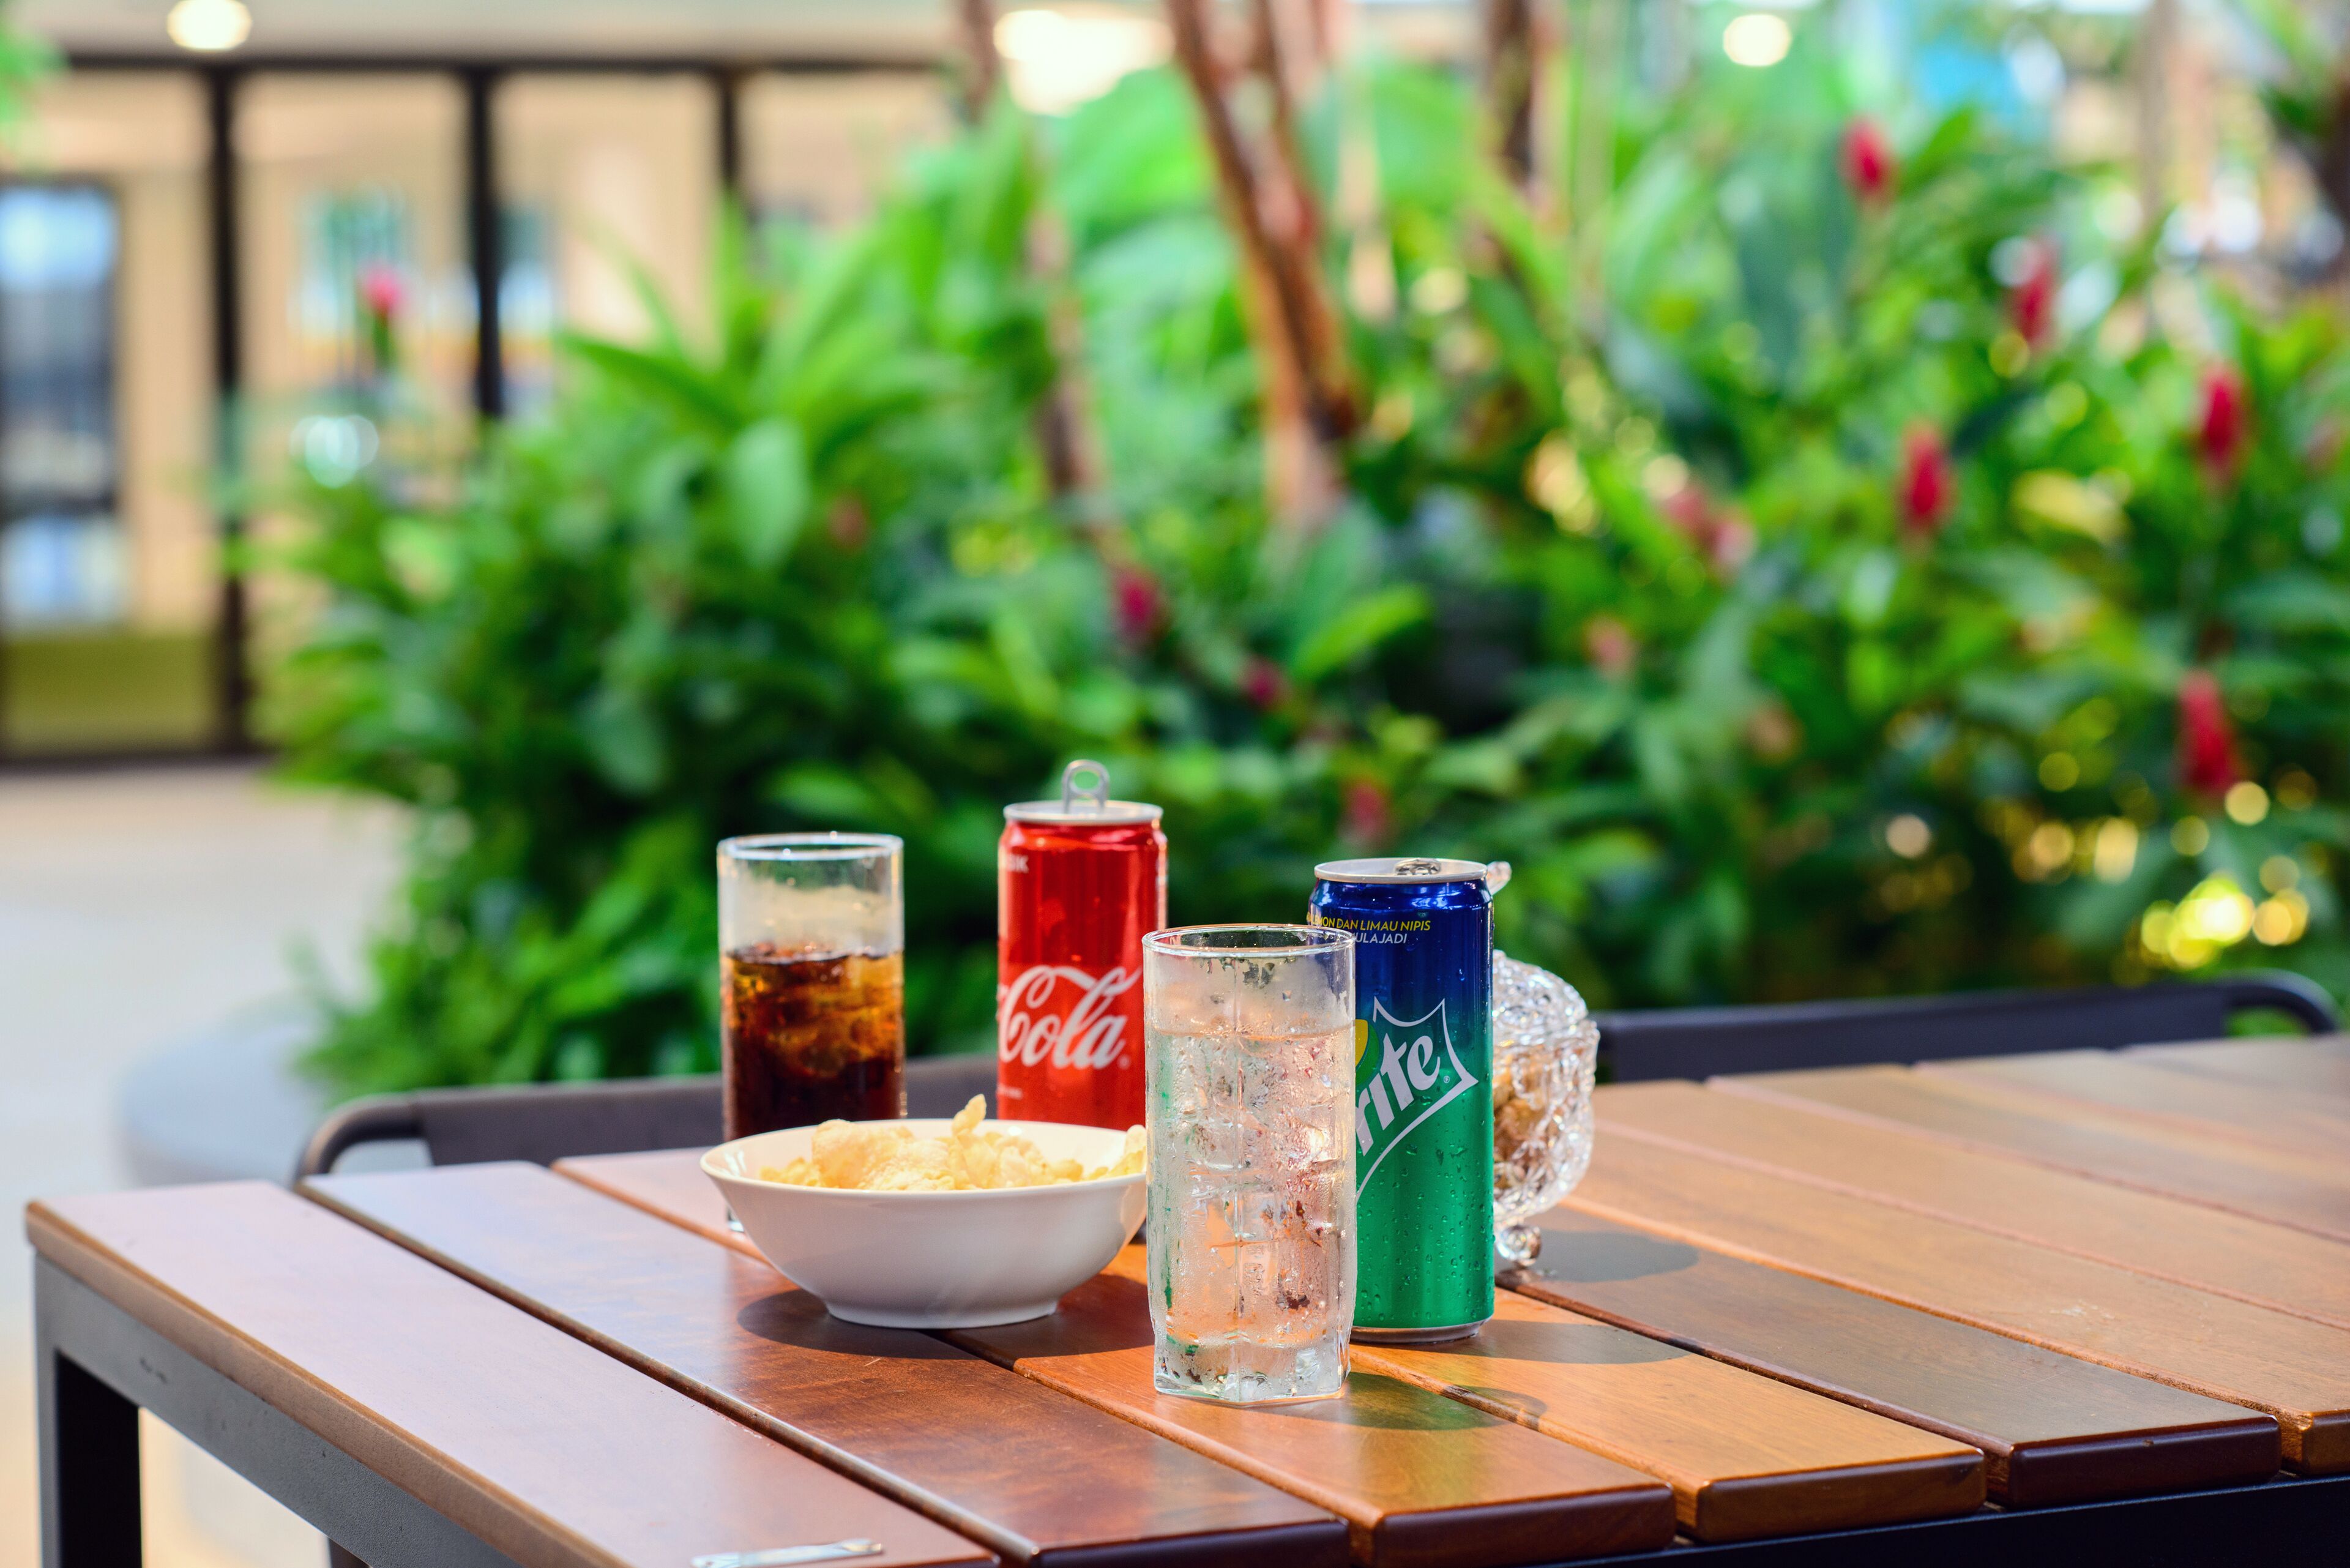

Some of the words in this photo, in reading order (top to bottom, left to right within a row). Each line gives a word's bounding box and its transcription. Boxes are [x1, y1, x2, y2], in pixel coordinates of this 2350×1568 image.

[1337, 918, 1359, 930] DAN
[1359, 919, 1398, 930] LIMAU
[1400, 920, 1431, 931] NIPIS
[998, 965, 1142, 1069] Cola
[1355, 1032, 1441, 1157] rite
